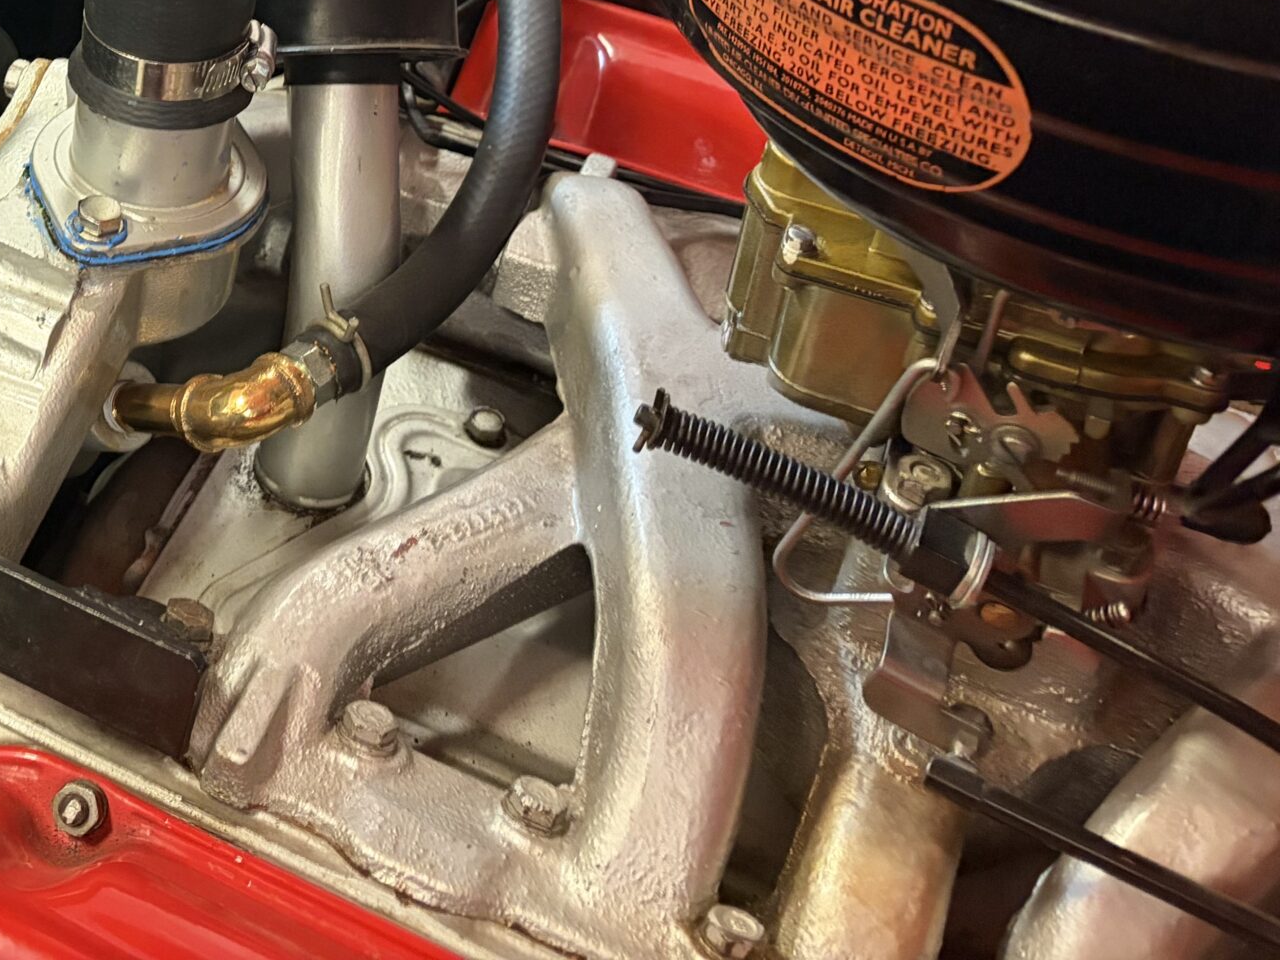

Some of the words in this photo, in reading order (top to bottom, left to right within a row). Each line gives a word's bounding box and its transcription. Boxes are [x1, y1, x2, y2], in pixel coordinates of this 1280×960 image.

[753, 5, 770, 24] TO
[772, 21, 855, 76] INDICATED
[860, 72, 890, 96] OIL
[896, 89, 954, 123] LEVEL
[961, 114, 1020, 145] WITH
[773, 5, 819, 43] FILTER
[828, 39, 847, 58] IN
[968, 104, 1016, 128] AND
[799, 1, 833, 26] AND
[844, 24, 914, 65] SERVICE
[859, 8, 977, 71] CLEANER
[790, 61, 821, 87] 20W
[824, 82, 887, 121] BELOW
[799, 53, 823, 77] OIL
[828, 69, 860, 96] FOR
[864, 87, 1013, 159] TEMPERATURES
